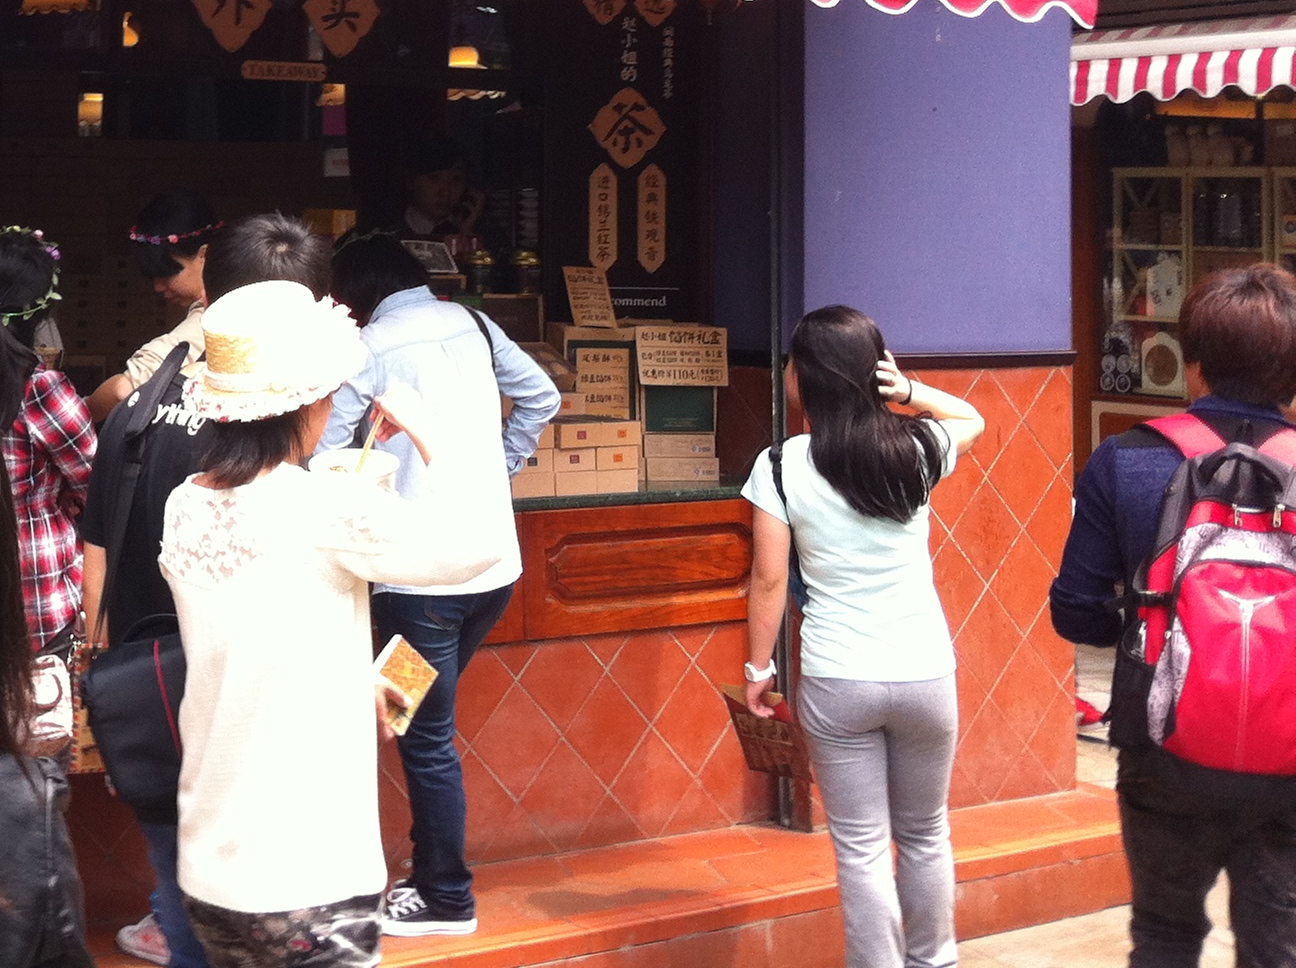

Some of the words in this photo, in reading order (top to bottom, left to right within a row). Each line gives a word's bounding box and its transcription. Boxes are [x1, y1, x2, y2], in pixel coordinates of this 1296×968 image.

[620, 16, 639, 82] 赵小姐的
[604, 101, 654, 154] 茶
